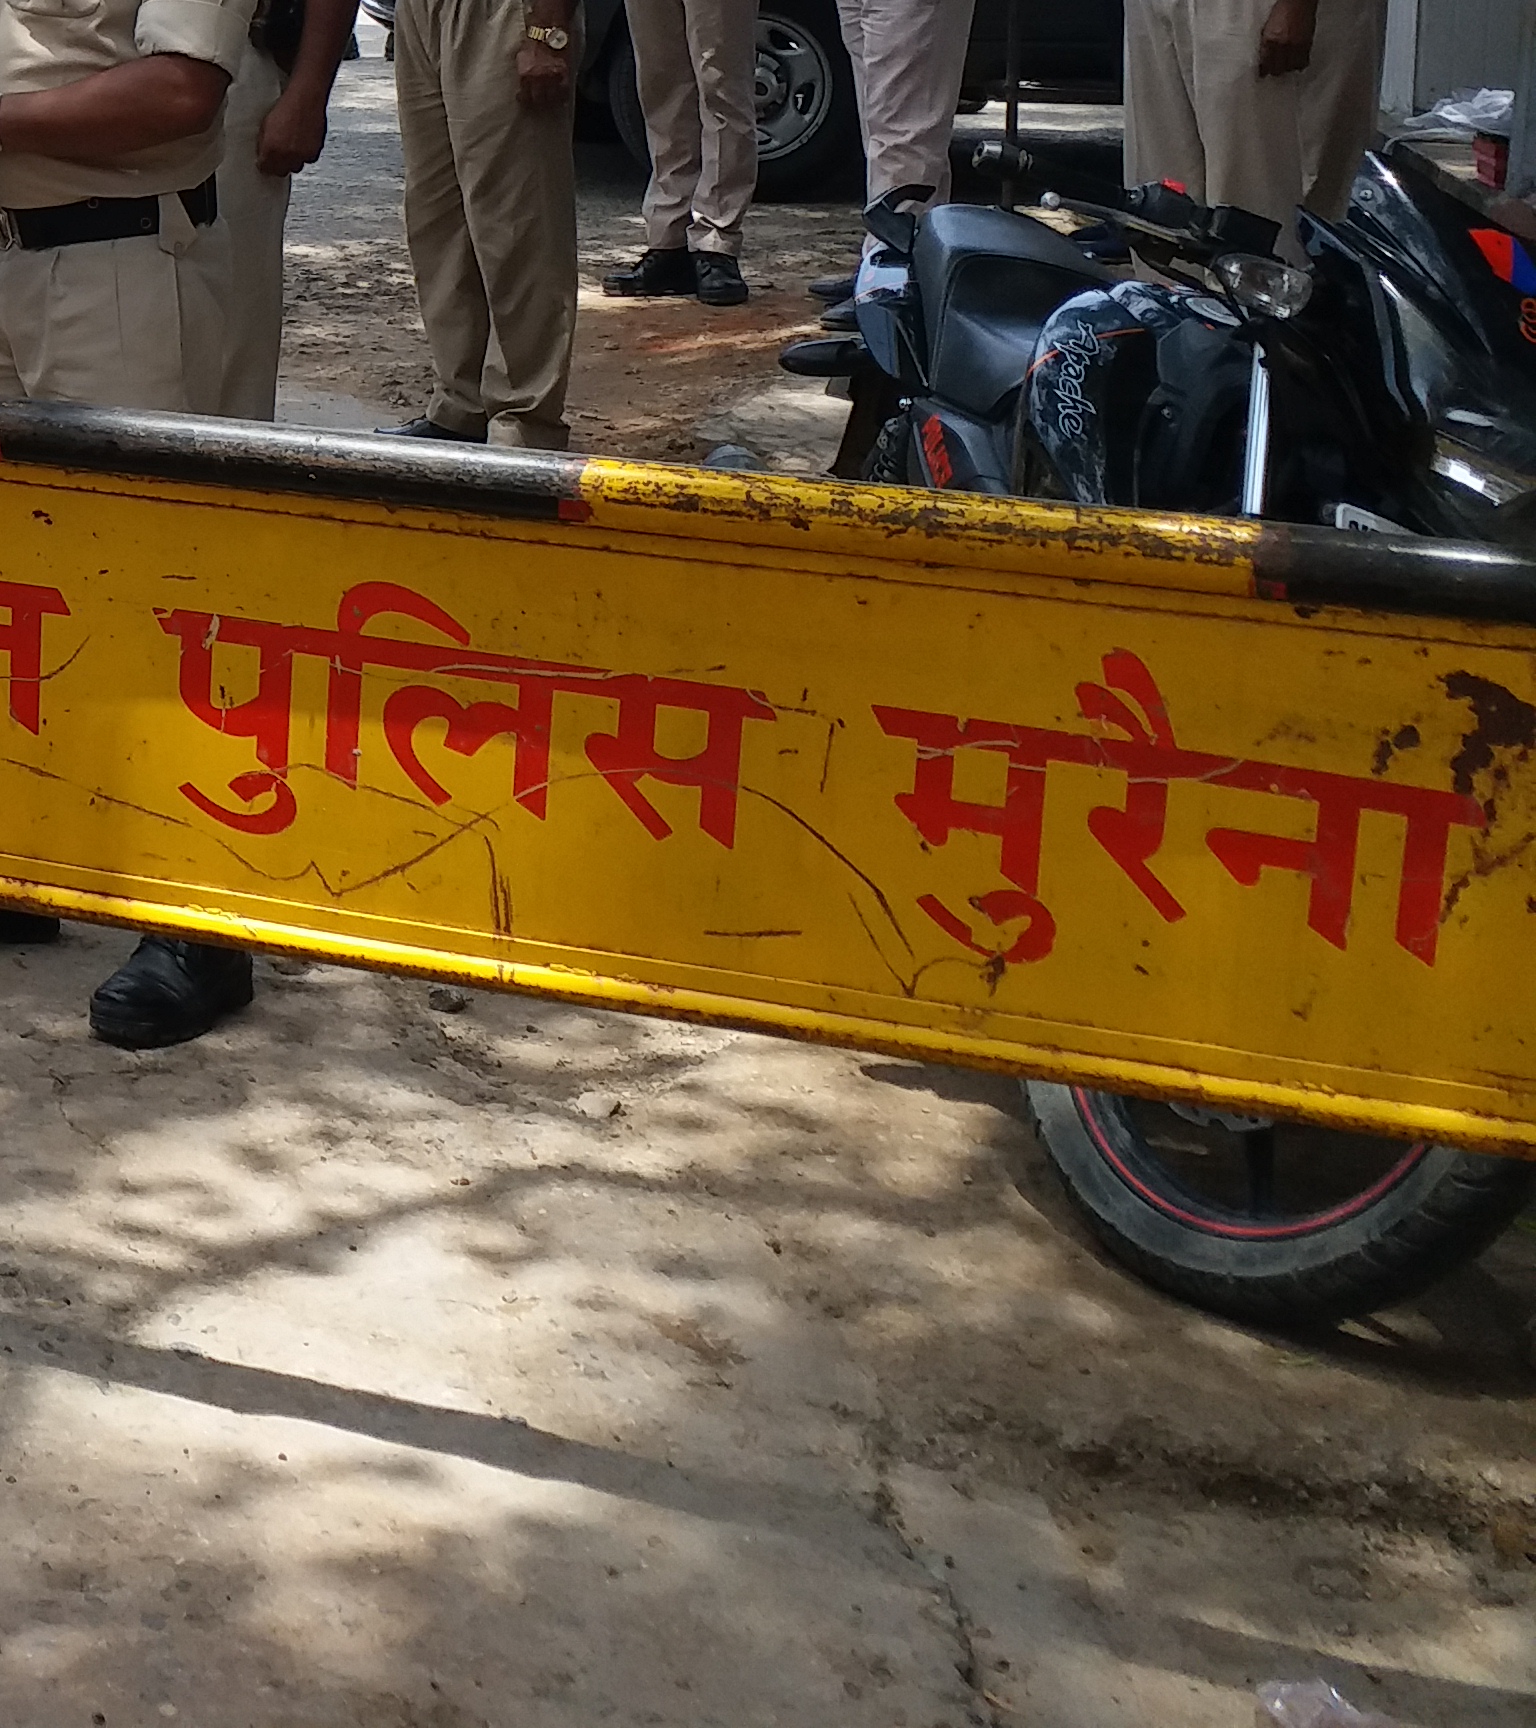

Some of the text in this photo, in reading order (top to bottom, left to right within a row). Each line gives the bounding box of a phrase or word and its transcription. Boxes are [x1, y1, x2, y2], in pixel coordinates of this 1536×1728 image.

[1053, 319, 1099, 440] Apache
[152, 578, 778, 850] पुलिस
[870, 647, 1489, 967] मुरैना
